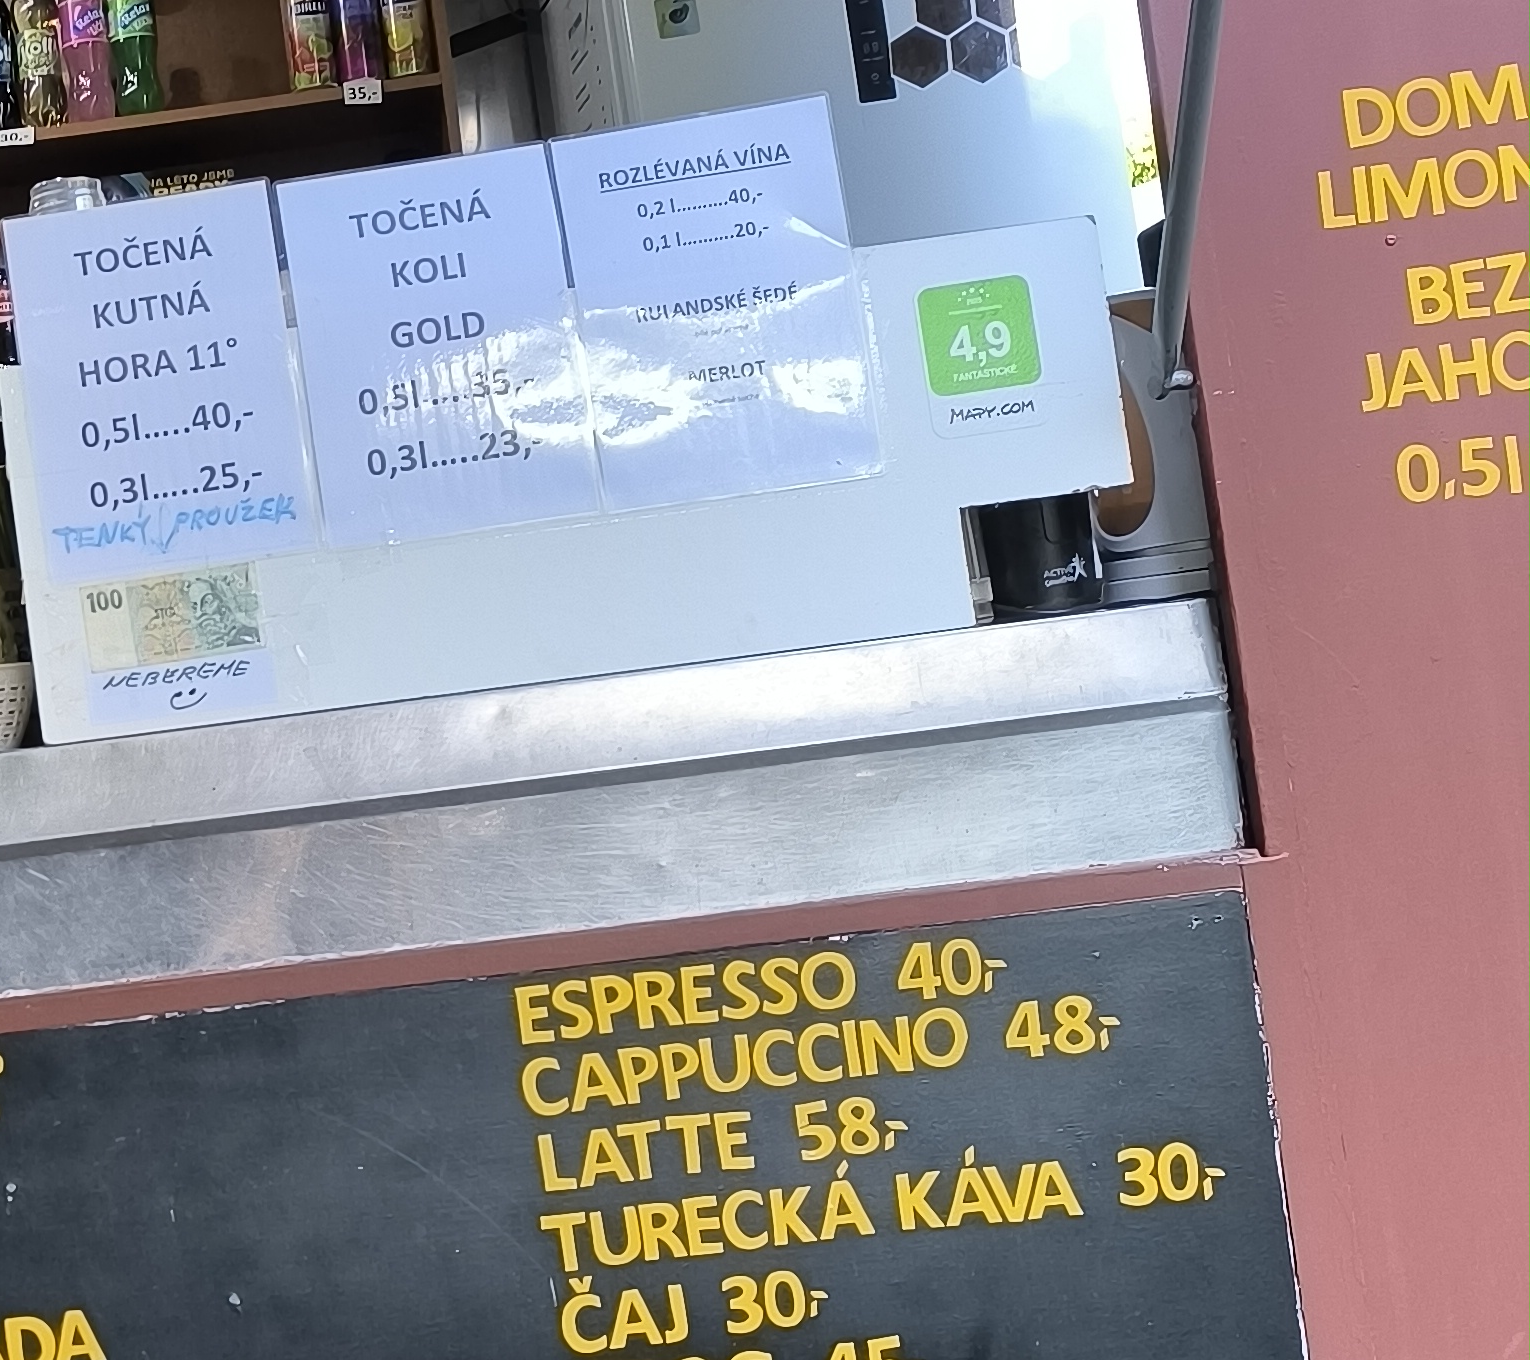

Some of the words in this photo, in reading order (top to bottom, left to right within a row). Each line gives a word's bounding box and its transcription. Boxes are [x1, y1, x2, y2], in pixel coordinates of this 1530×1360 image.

[348, 87, 378, 101] 35,-
[598, 148, 730, 189] ROZLÉVANÁ
[733, 142, 790, 167] VÍNA
[348, 188, 491, 239] TOČENÁ
[637, 200, 665, 219] 0,2
[73, 225, 213, 277] TOČENÁ
[643, 234, 671, 252] 0,1
[390, 252, 467, 288] KOLI
[92, 280, 210, 330] KUTNÁ
[390, 310, 486, 348] GOLD
[950, 320, 1011, 367] 4,9
[78, 349, 177, 387] HORA
[186, 336, 239, 373] 11°
[950, 399, 1035, 425] MAPY.COM
[86, 589, 123, 614] 100
[102, 659, 251, 691] NEBEREME
[514, 951, 856, 1045] ESPRESSO
[519, 1007, 969, 1118] CAPPUCCINO
[536, 1109, 756, 1194] LATTE
[540, 1160, 875, 1273] TURECKÁ
[895, 1145, 1082, 1231] KÁVA
[559, 1275, 689, 1356] ČAJ
